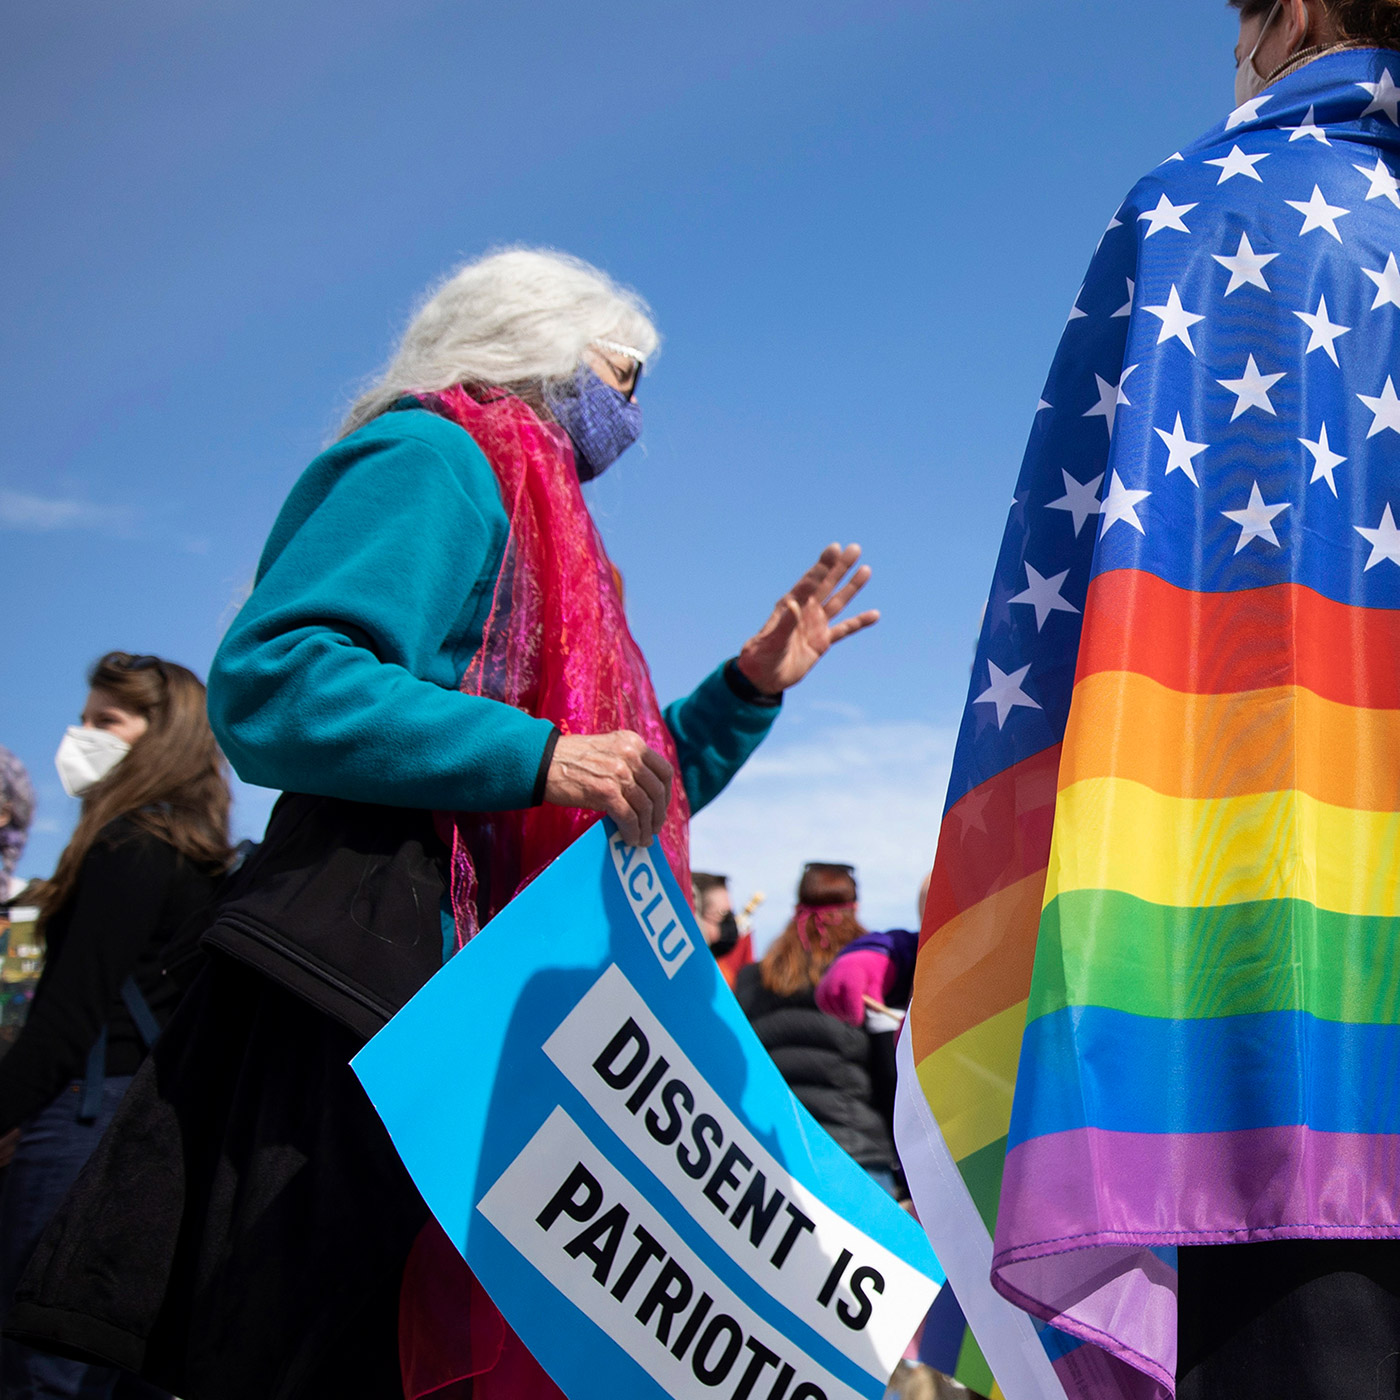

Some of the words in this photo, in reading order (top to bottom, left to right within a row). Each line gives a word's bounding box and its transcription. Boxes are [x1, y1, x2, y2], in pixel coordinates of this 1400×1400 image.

[614, 840, 687, 963] ACLU
[535, 1161, 828, 1400] PATRIOTI
[592, 1016, 816, 1271] DISSENT
[816, 1248, 885, 1331] IS
